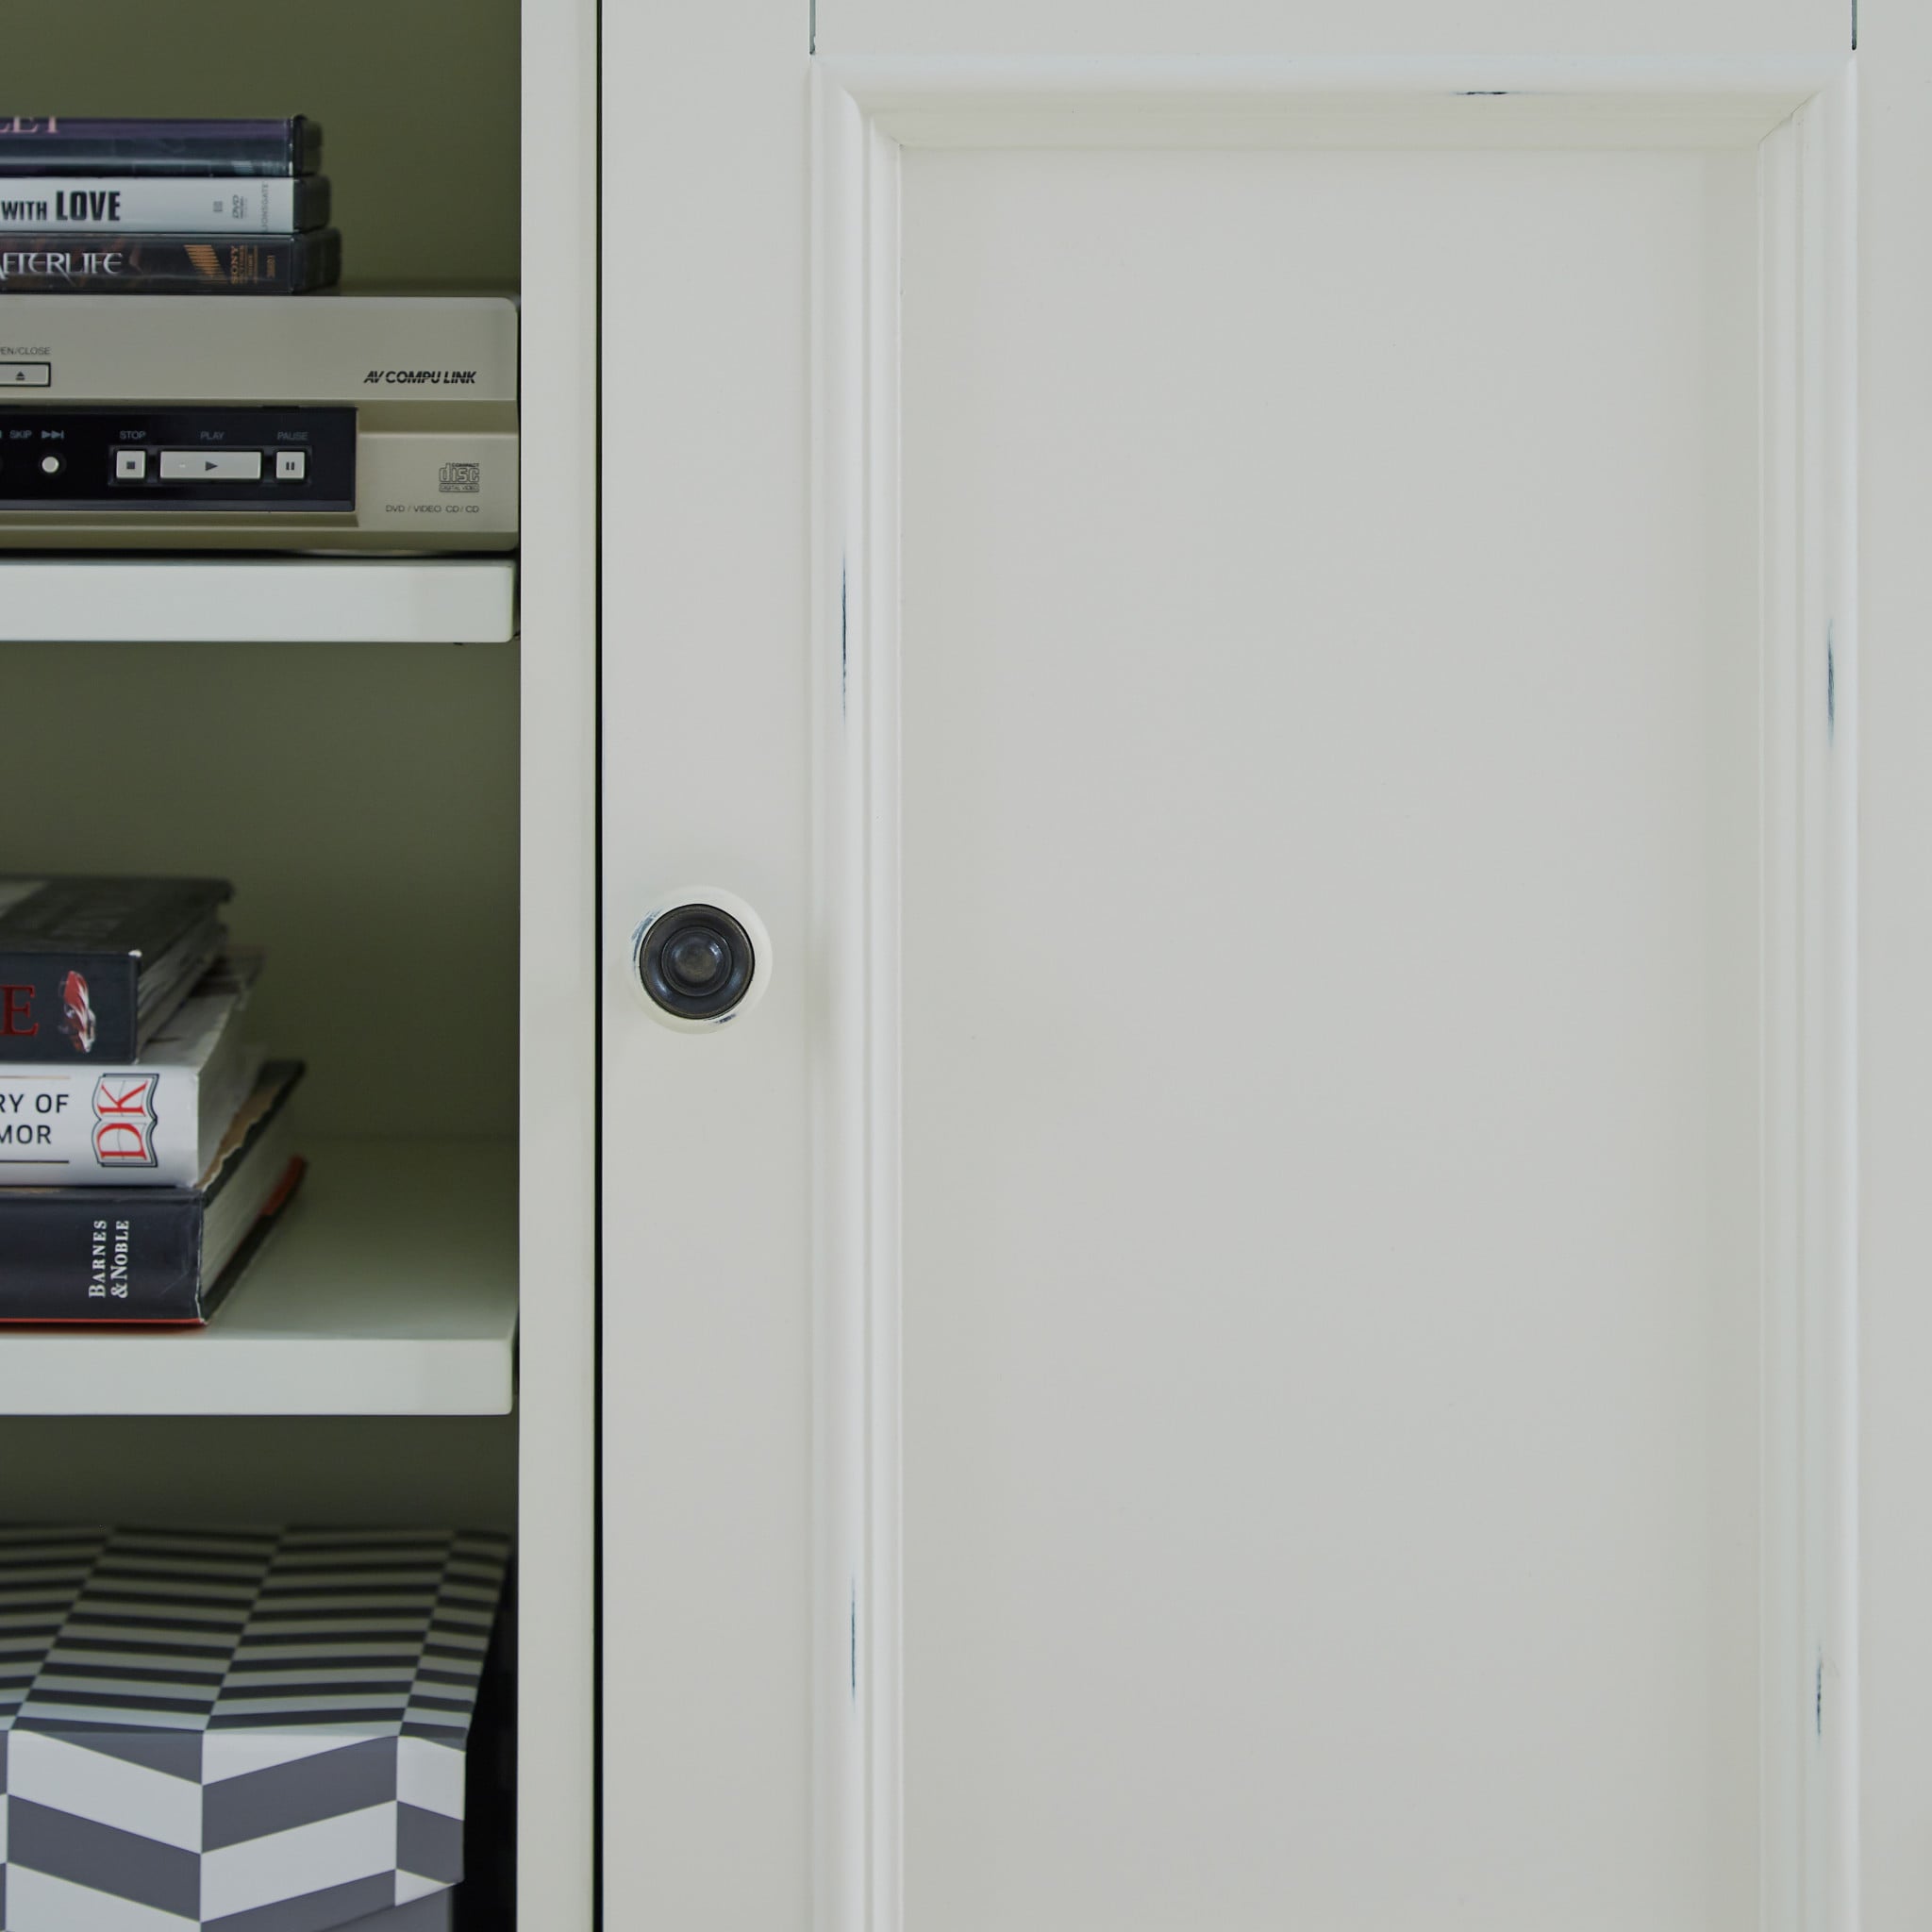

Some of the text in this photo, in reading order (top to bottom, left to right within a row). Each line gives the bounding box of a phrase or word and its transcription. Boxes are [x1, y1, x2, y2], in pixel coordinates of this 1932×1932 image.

[1, 191, 121, 221] WITH LOVE
[0, 347, 51, 356] EN/CLOSE
[363, 371, 476, 383] AV COMPU LINK
[9, 430, 32, 439] SKIP
[120, 430, 146, 440] STOP
[200, 431, 225, 441] PLAY
[277, 431, 308, 441] PAUSE
[0, 985, 40, 1036] E
[35, 1094, 70, 1113] OF
[96, 1080, 149, 1161] DK
[0, 1124, 52, 1144] MOR
[89, 1220, 107, 1298] BARNES
